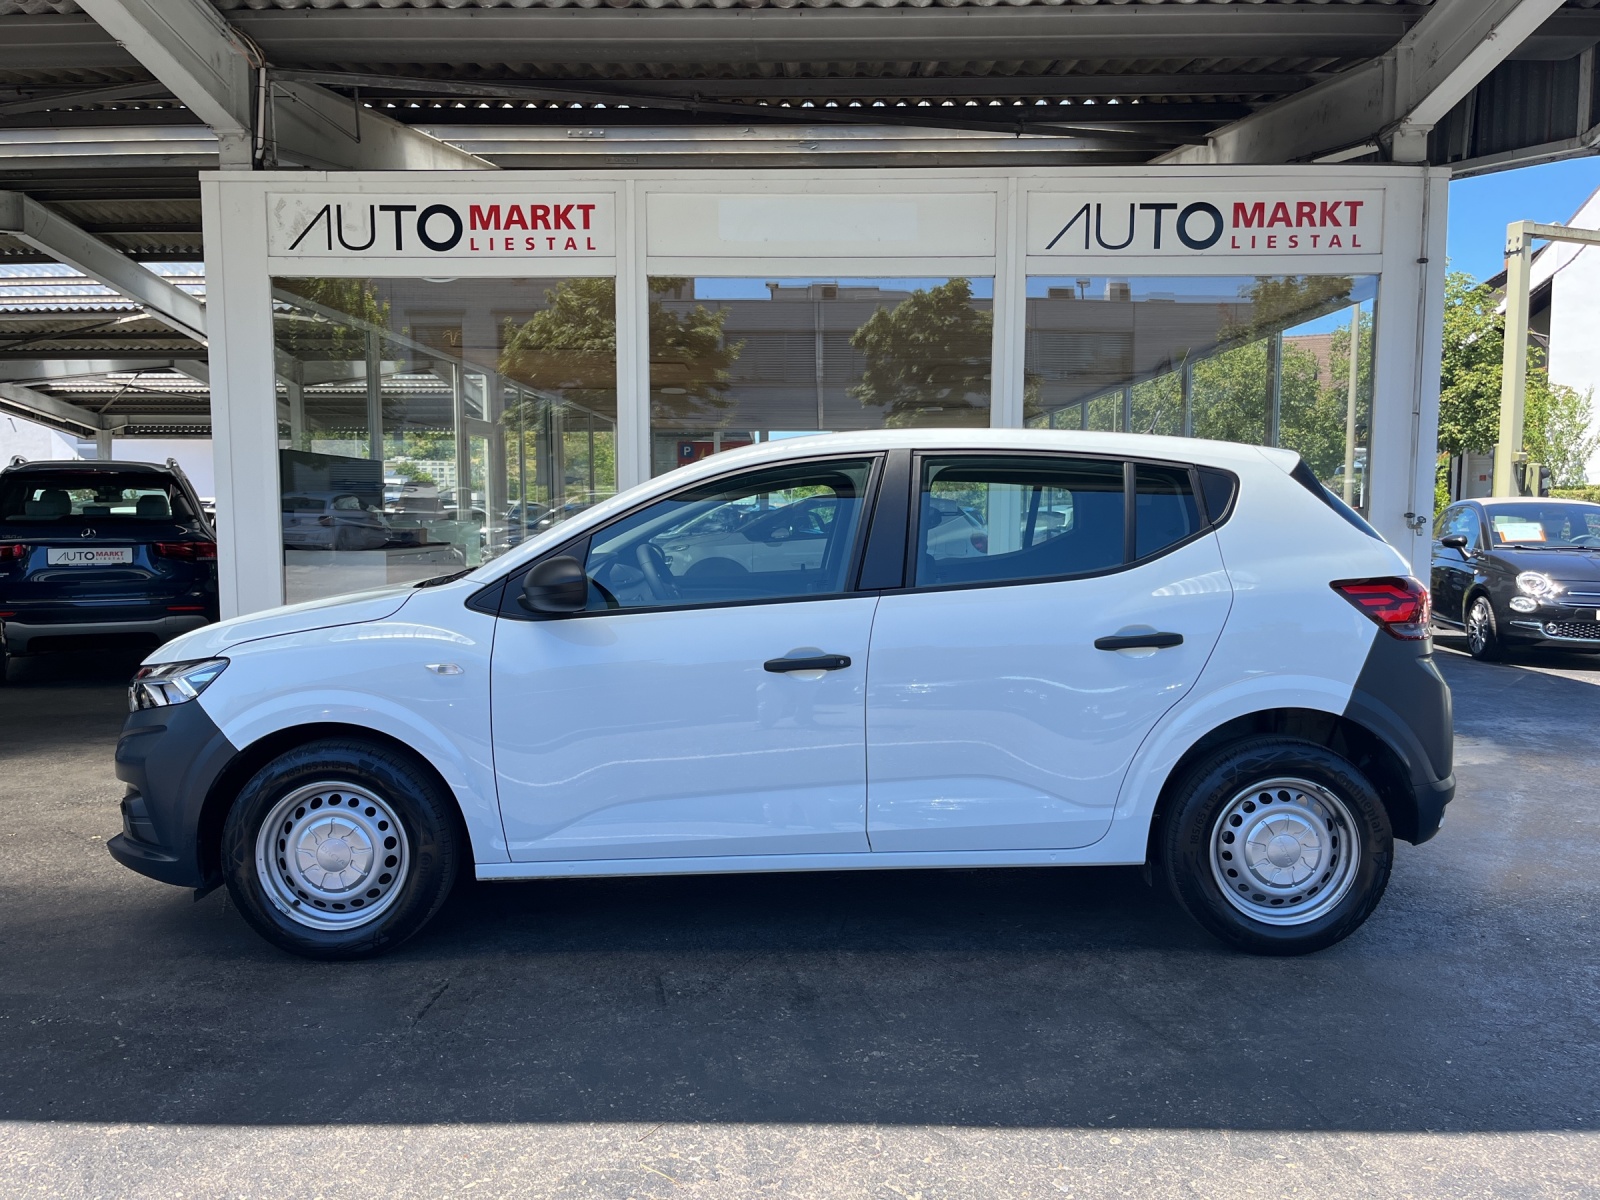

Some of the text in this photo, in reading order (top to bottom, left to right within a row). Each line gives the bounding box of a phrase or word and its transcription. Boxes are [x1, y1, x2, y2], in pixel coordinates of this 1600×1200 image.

[288, 204, 596, 252] AUTO MARKT
[470, 237, 596, 251] LIESTAL
[1045, 201, 1364, 250] AUTO MARKT
[1231, 234, 1362, 249] LIESTAL
[56, 551, 95, 561] AUTO
[1190, 812, 1206, 844] 185/65
[1202, 802, 1211, 811] R
[1208, 792, 1218, 803] 15
[1334, 771, 1384, 833] Continental
